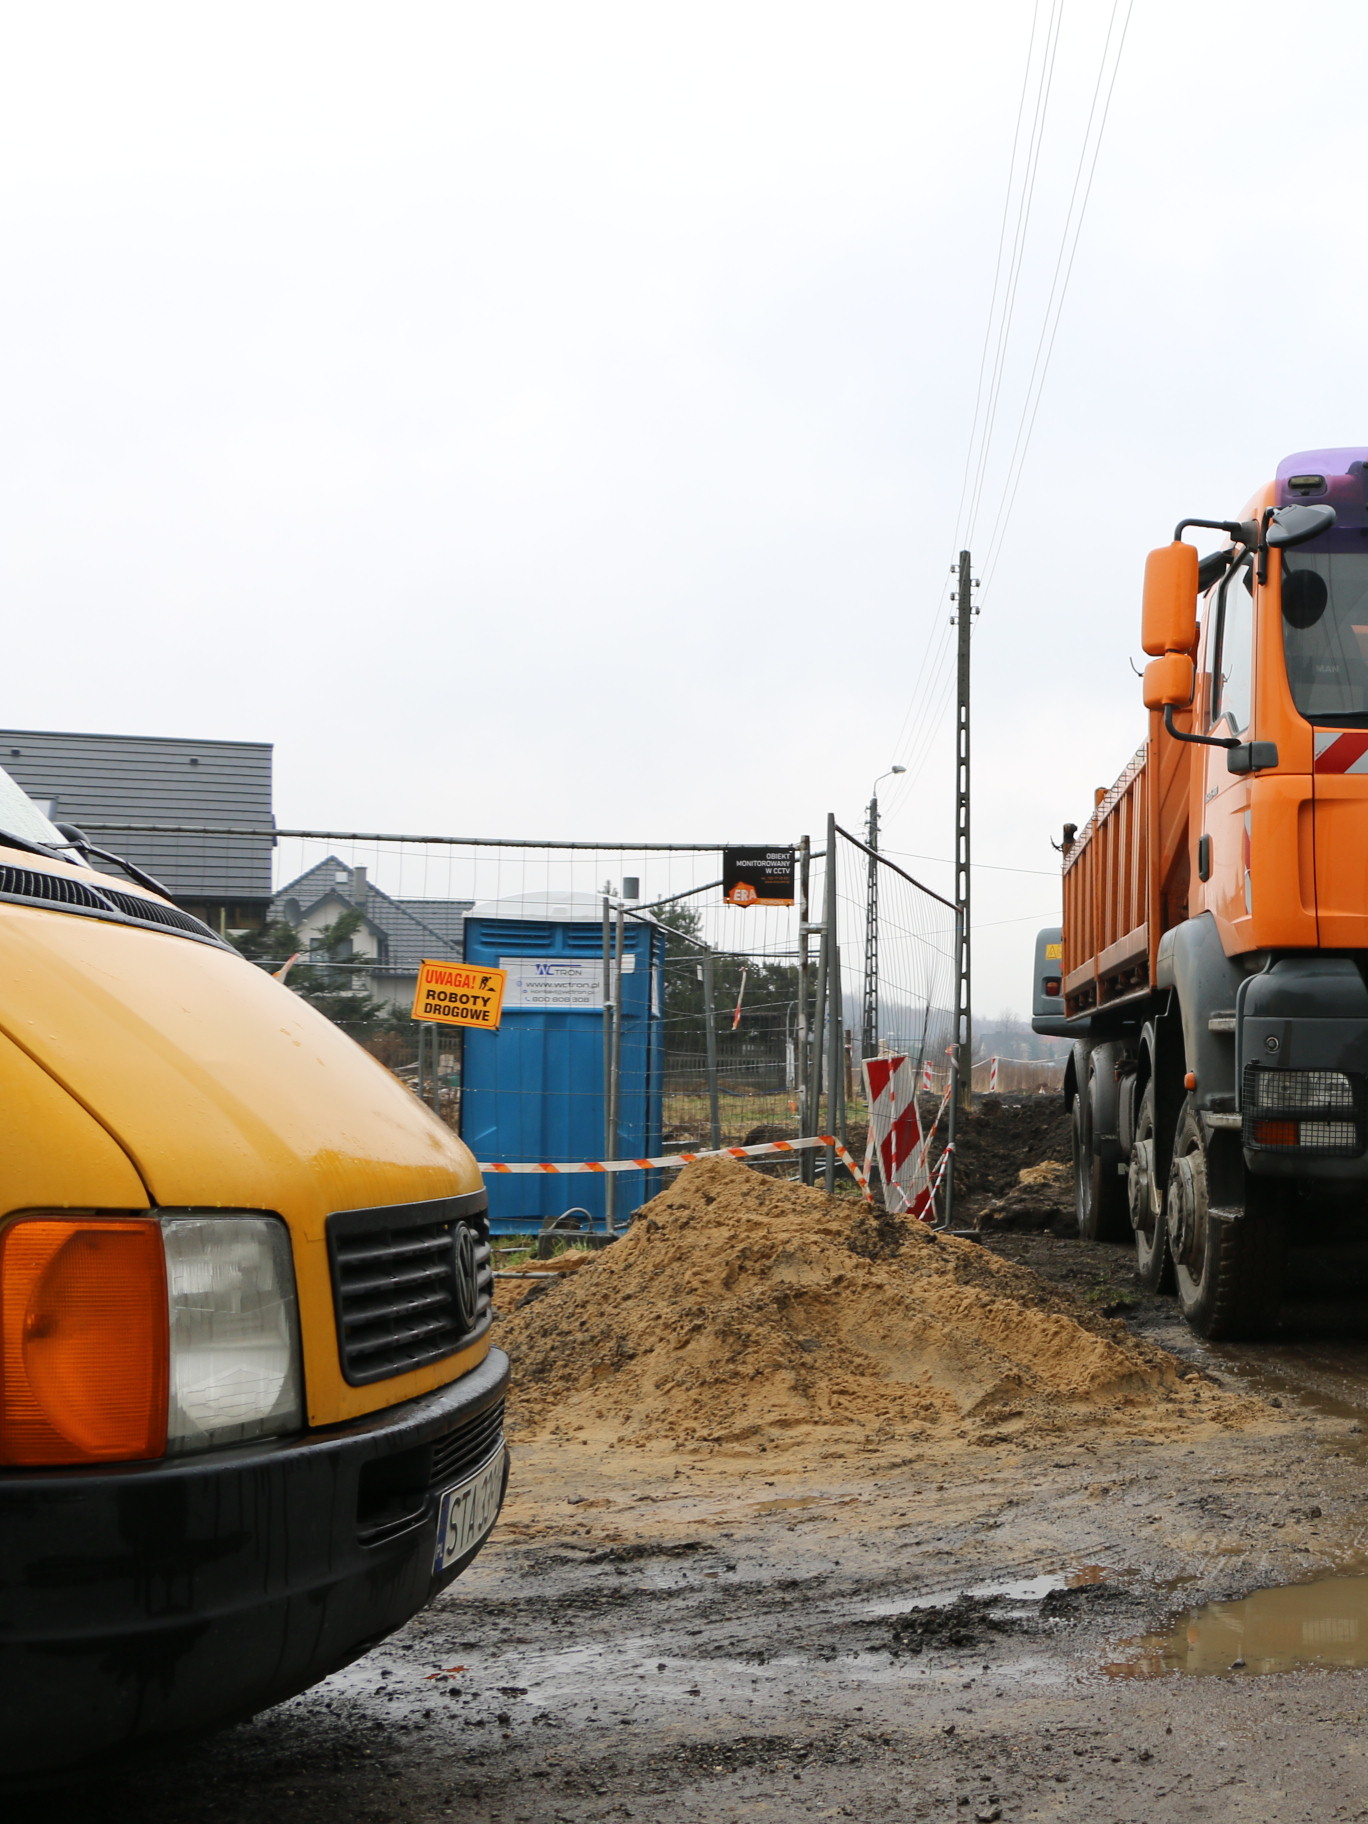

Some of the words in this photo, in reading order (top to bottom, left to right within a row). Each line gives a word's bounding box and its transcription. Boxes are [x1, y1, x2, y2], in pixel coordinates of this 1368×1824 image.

[733, 888, 758, 901] ERA
[425, 969, 476, 989] UWAGA!
[526, 981, 600, 989] www.wctron.pl
[426, 989, 491, 1007] ROBOTY
[424, 1002, 490, 1021] DROGOWE
